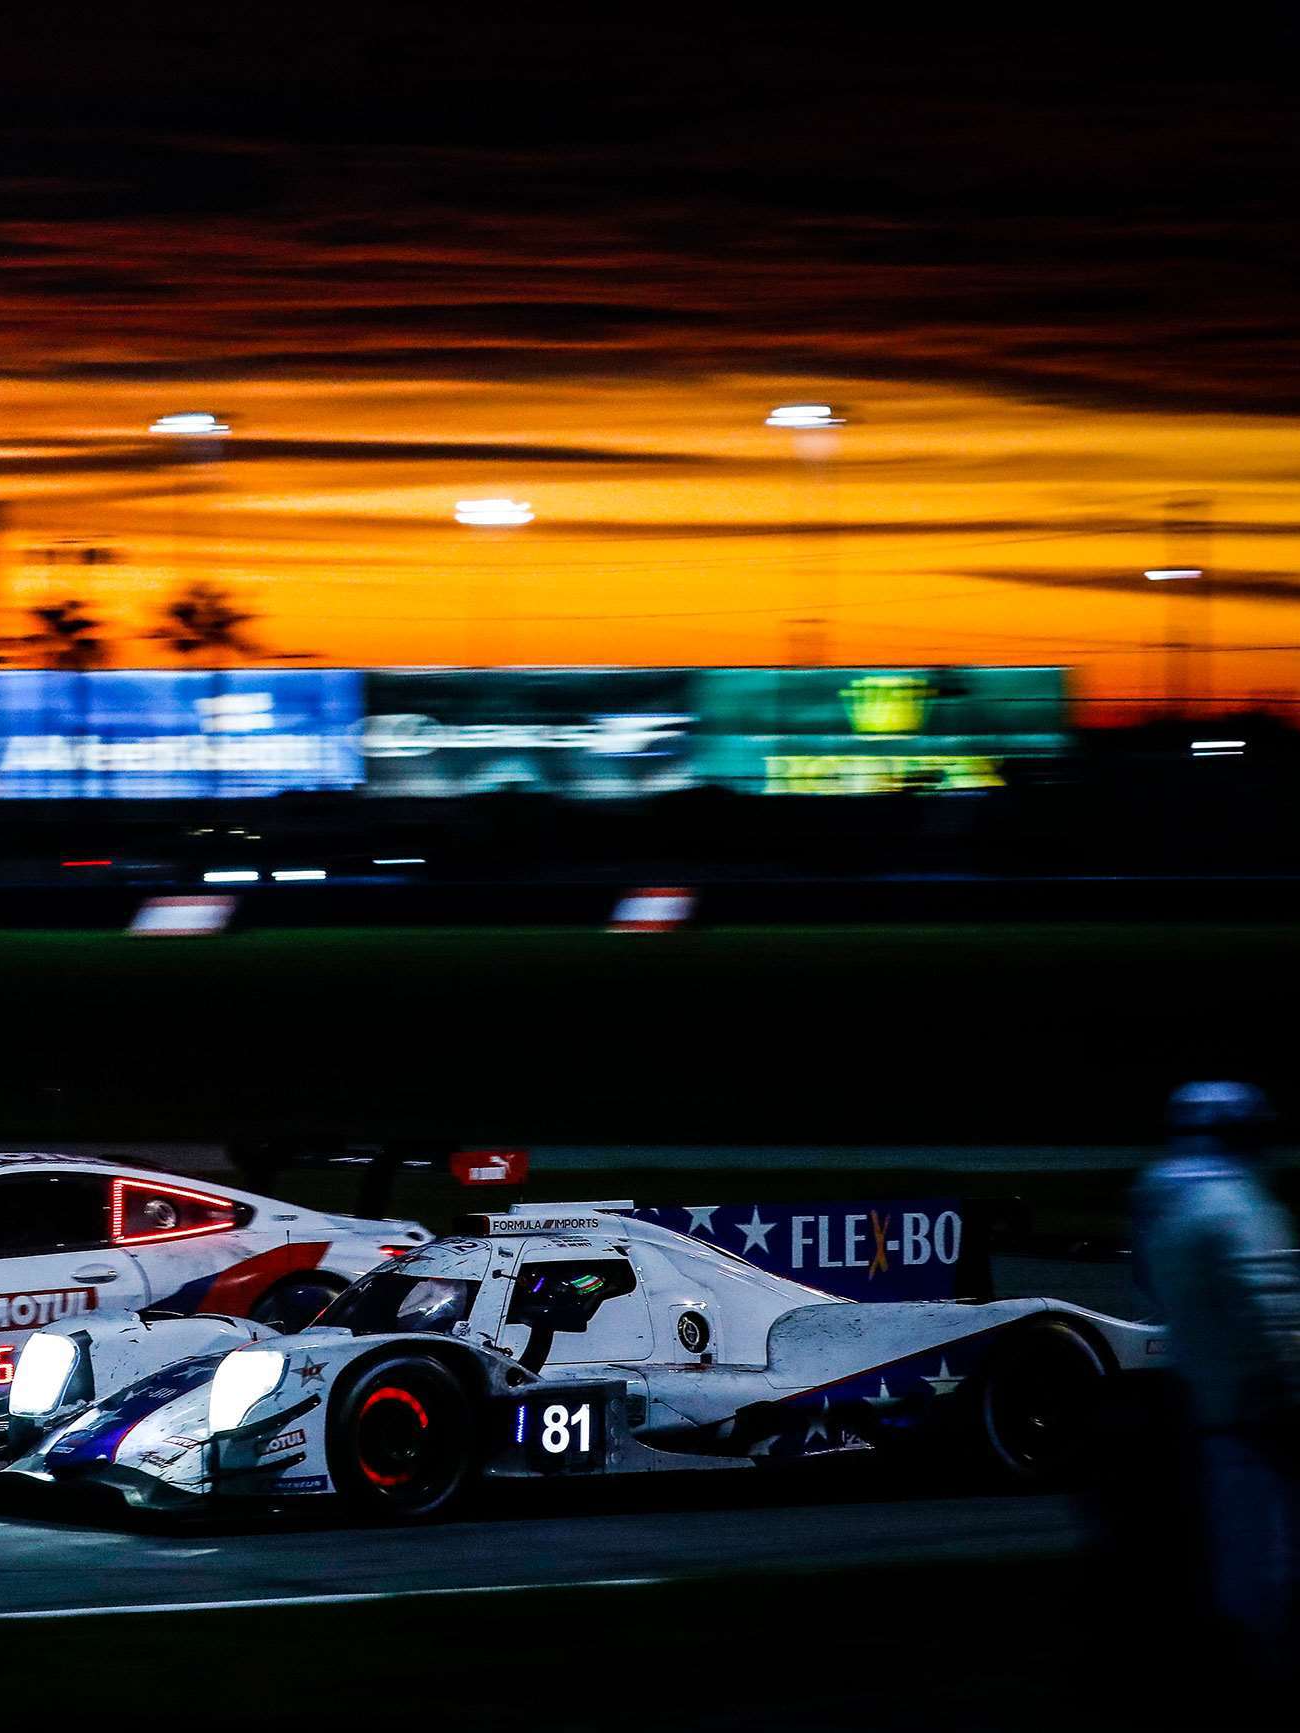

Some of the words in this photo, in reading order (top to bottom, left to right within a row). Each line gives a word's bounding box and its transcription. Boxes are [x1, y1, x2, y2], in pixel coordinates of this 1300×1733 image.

[493, 1220, 541, 1231] FORMULA
[554, 1218, 599, 1229] IMPORTS
[541, 1403, 590, 1453] 81
